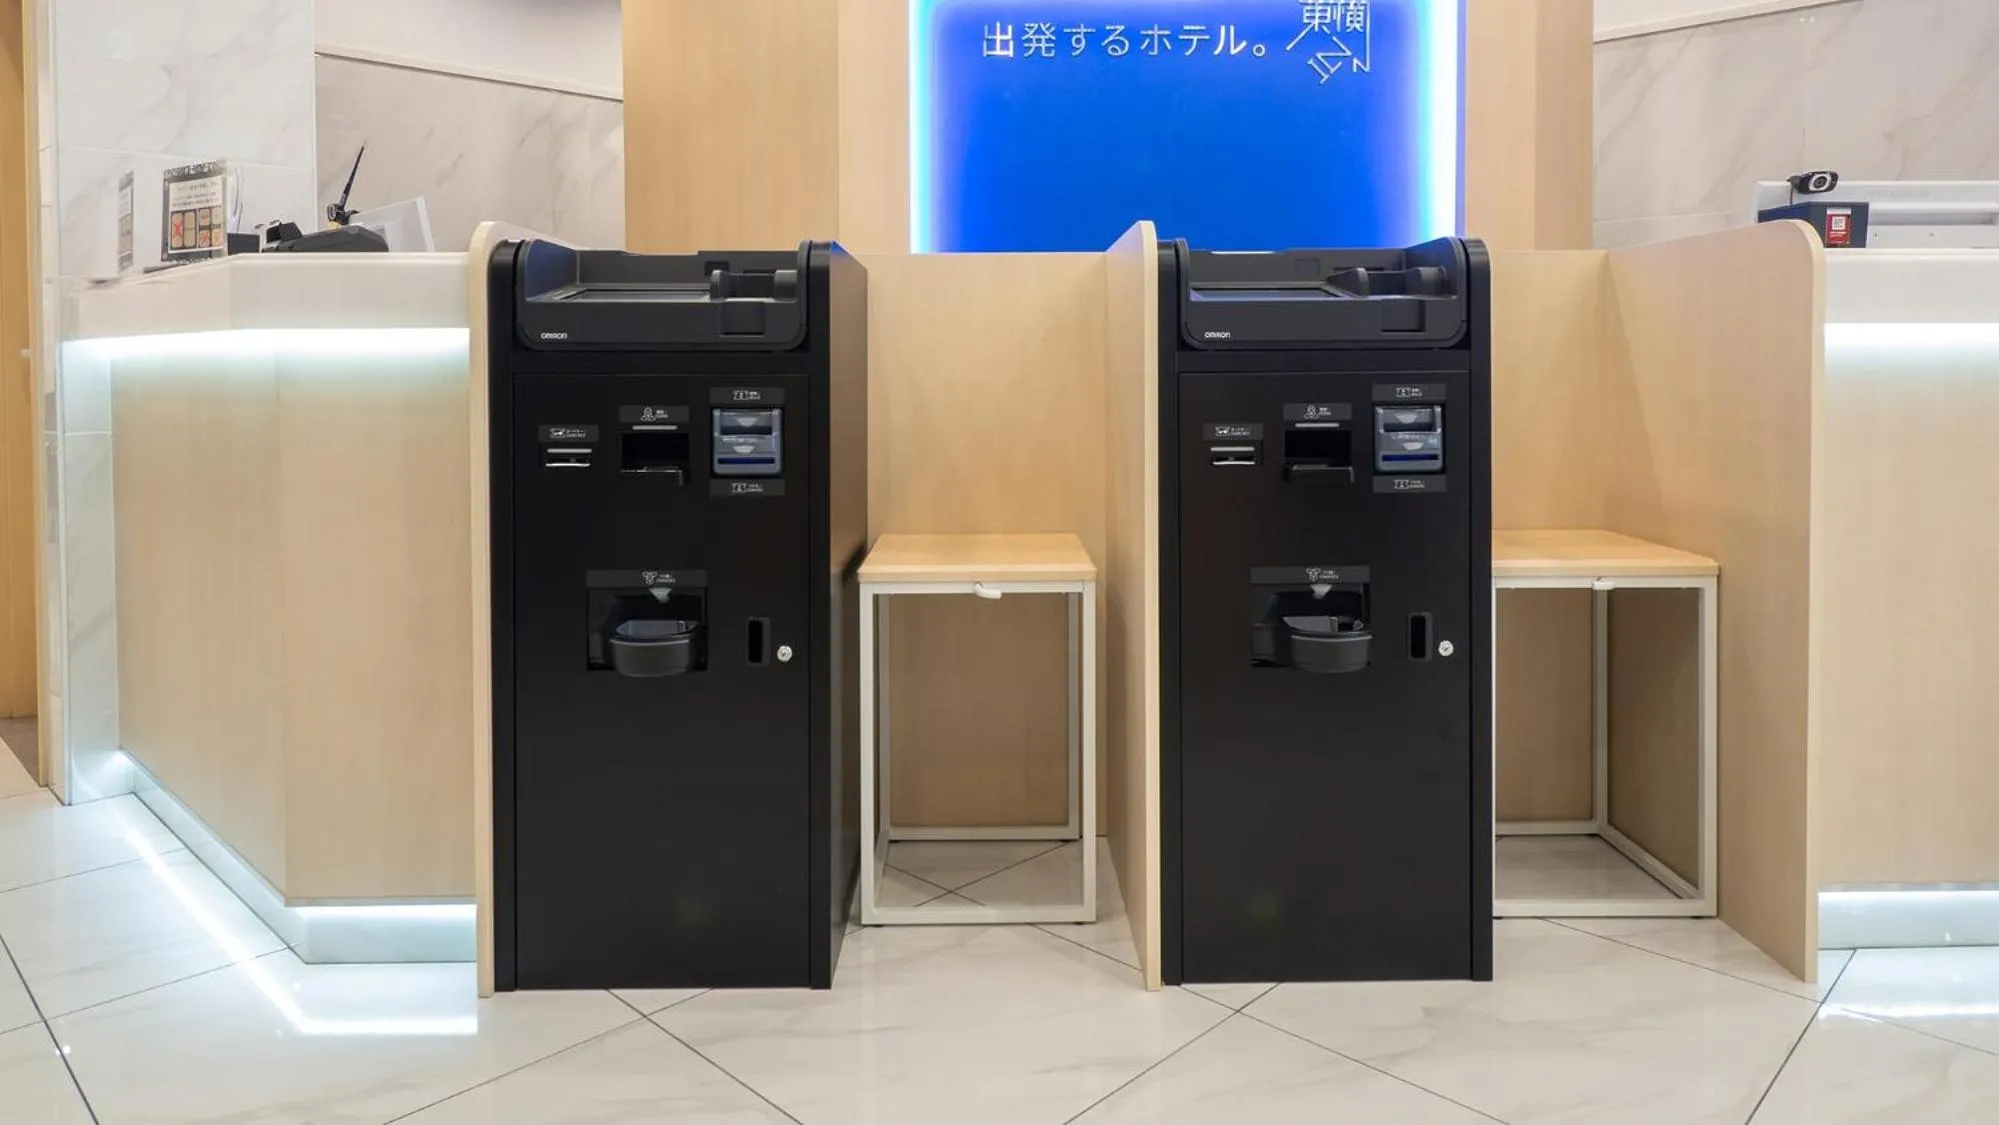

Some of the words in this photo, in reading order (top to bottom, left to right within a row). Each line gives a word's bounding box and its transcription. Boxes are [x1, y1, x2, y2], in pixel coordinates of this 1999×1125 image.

[982, 21, 1267, 58] 出発するホテル。
[540, 332, 568, 340] OMRON
[1204, 331, 1231, 339] OMRON
